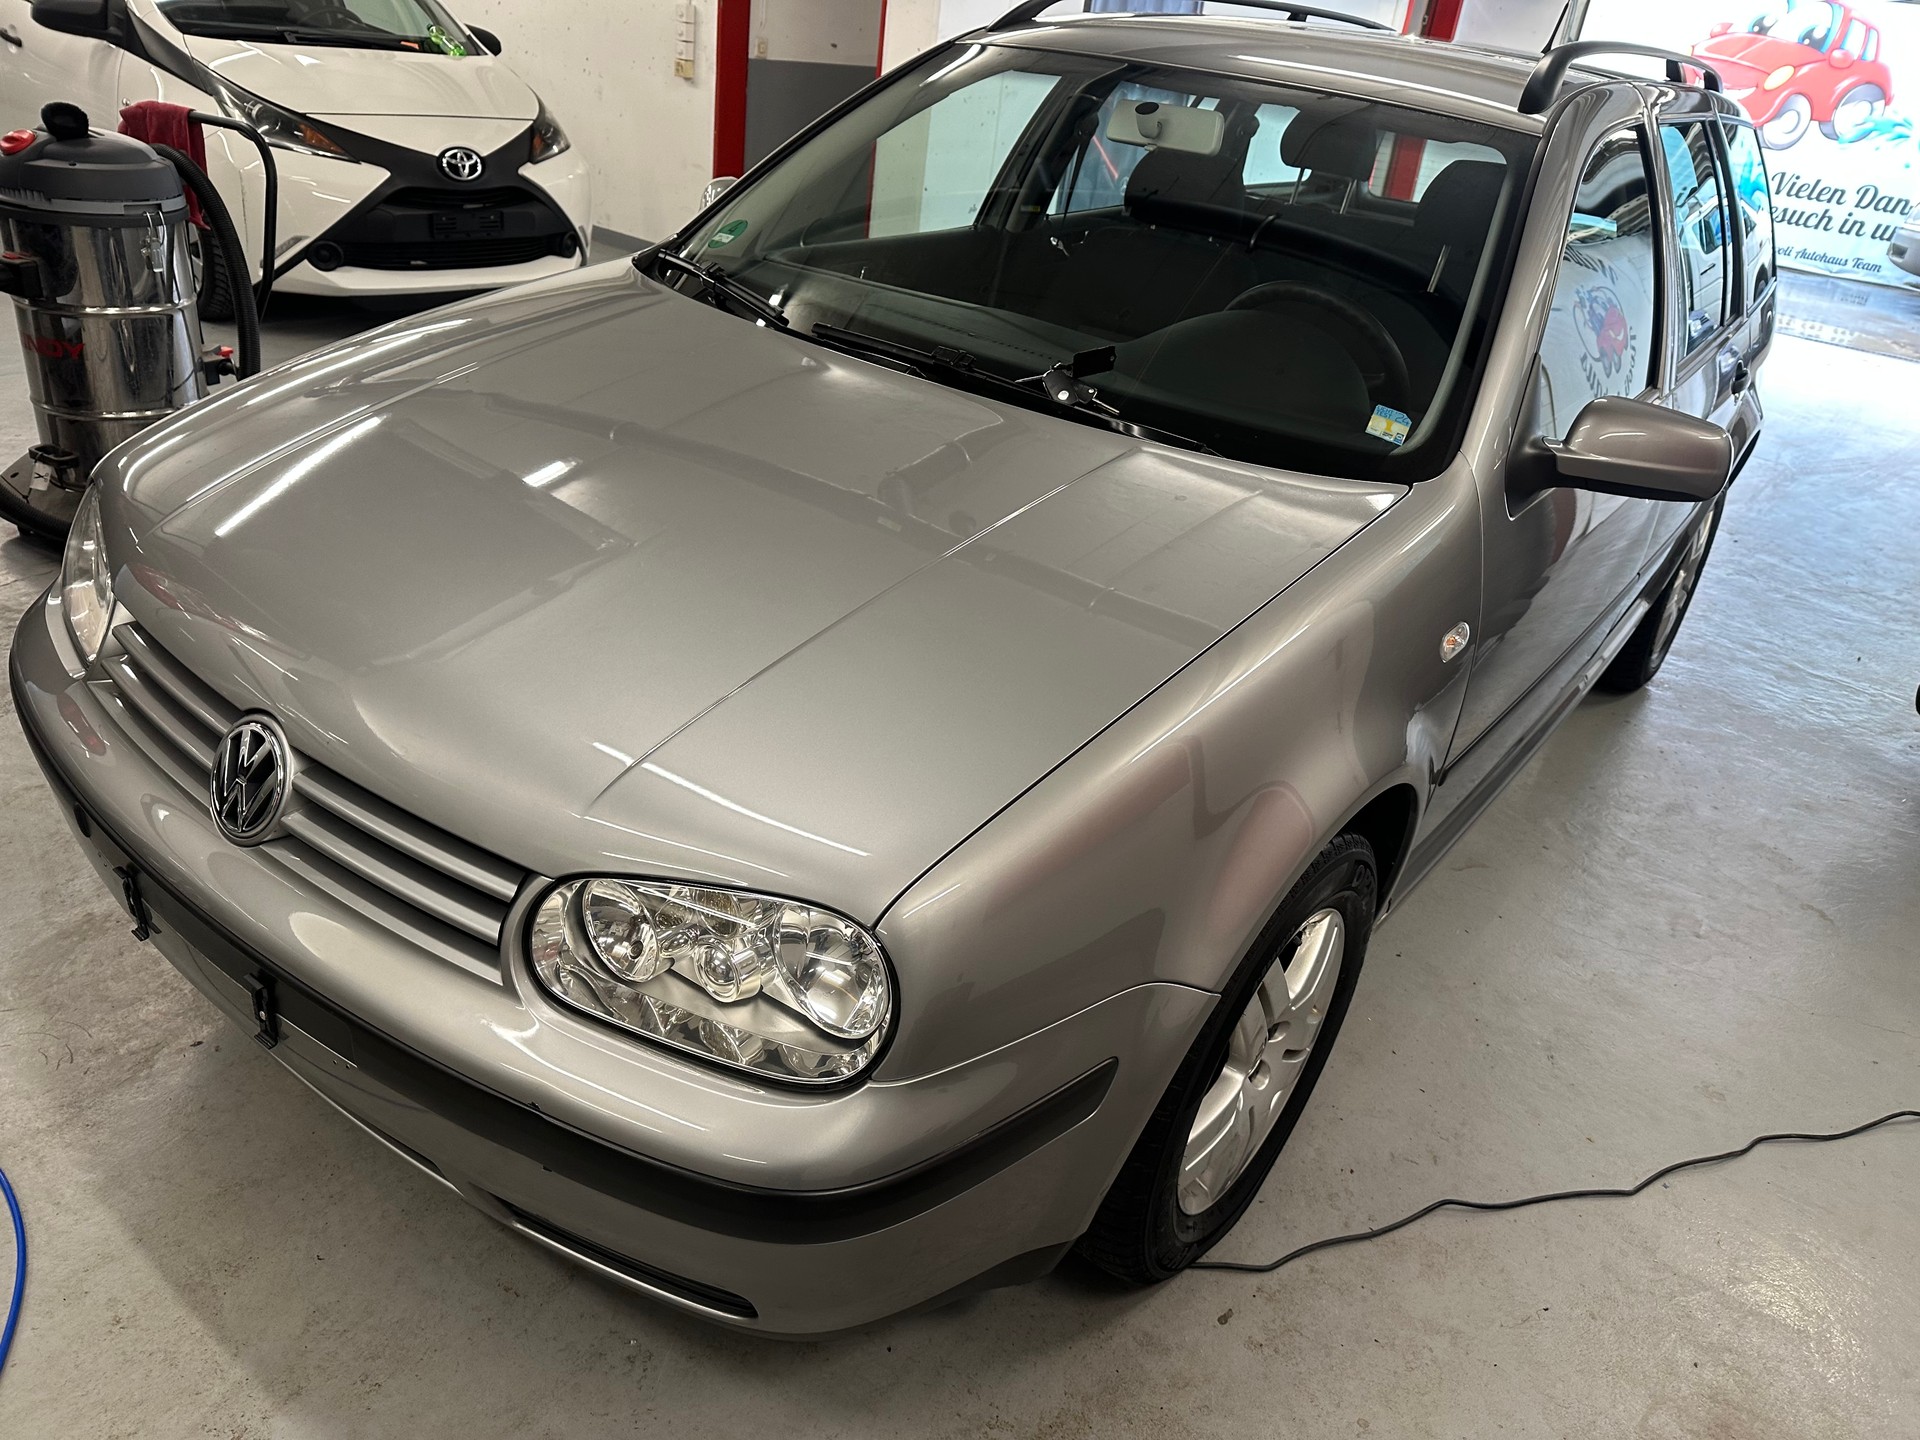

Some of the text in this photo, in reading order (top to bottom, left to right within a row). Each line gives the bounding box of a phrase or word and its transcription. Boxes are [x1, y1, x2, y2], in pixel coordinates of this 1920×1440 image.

[1771, 171, 1914, 216] Vielen Dan
[1770, 206, 1834, 232] esuch
[1838, 211, 1866, 237] in
[1776, 246, 1882, 273] oli Autohaus Team
